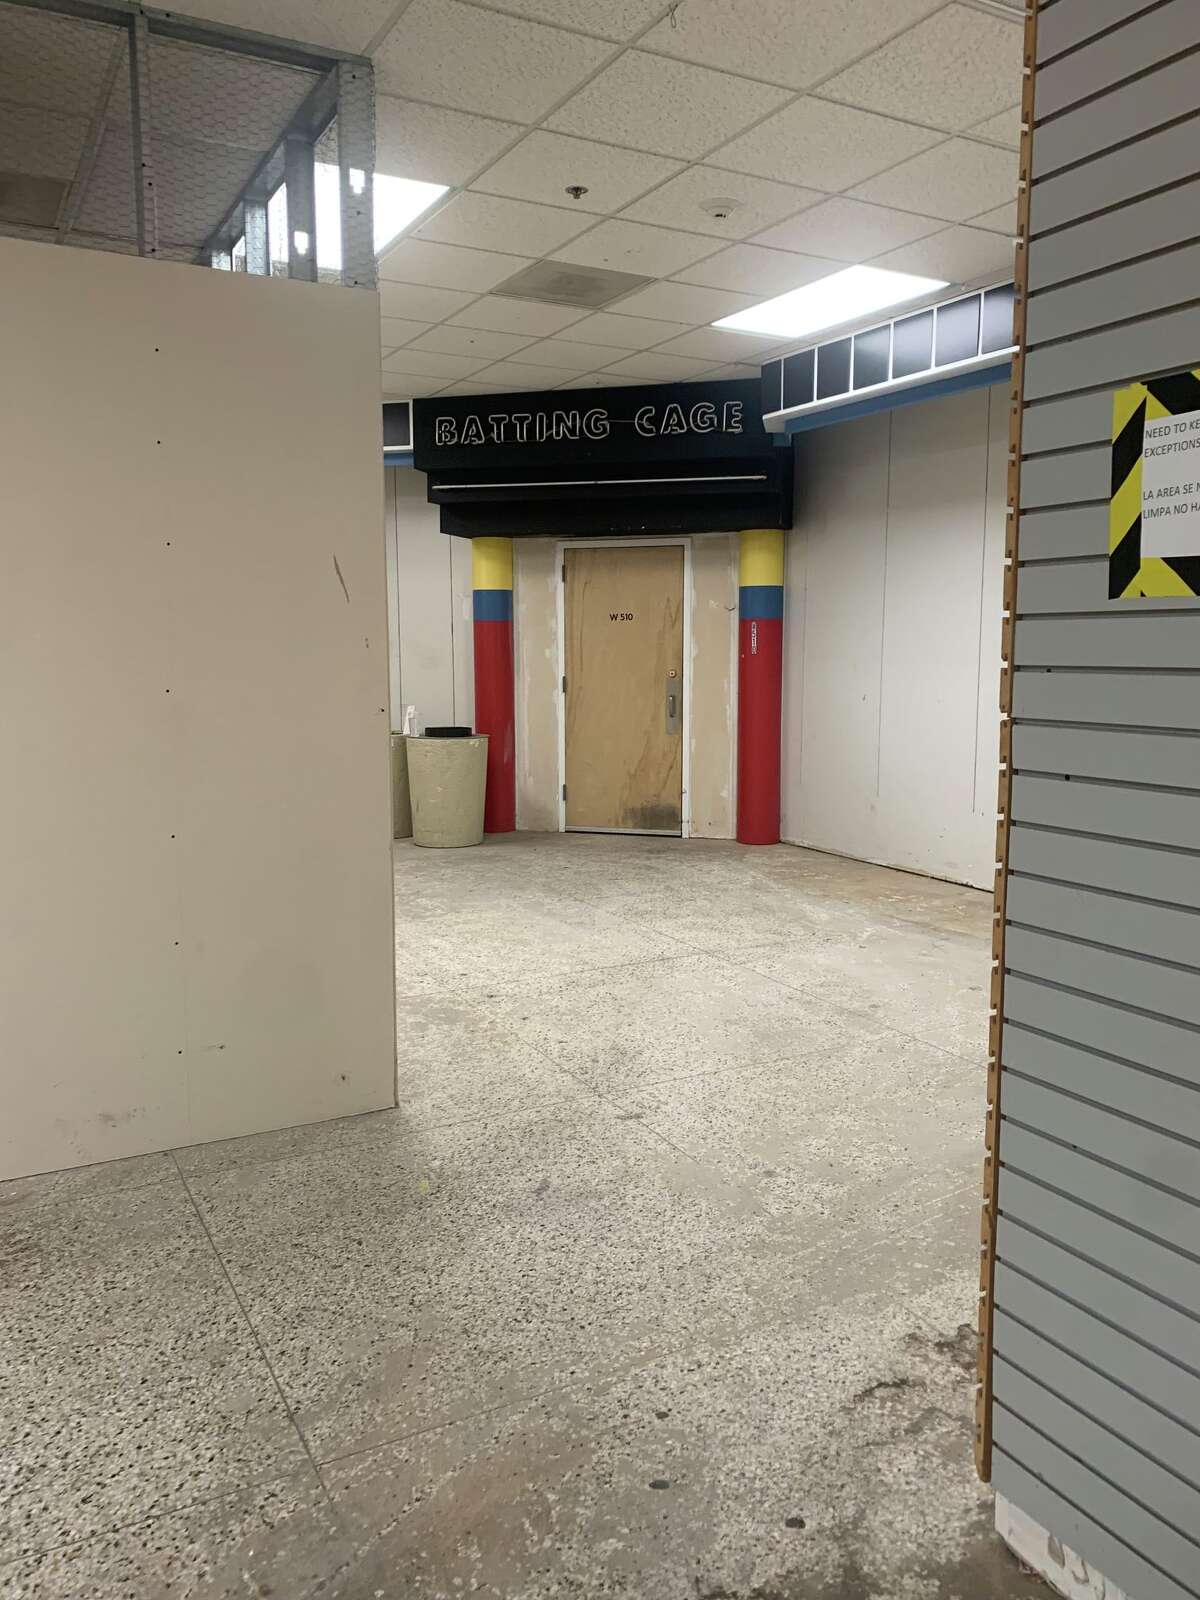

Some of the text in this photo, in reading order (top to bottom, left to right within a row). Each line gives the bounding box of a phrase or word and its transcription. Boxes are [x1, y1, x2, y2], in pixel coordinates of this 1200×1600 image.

[435, 401, 744, 446] BATTING CAGE
[1145, 425, 1171, 439] NEED
[1174, 422, 1187, 434] TO
[1144, 438, 1200, 458] EXCEPTIONS
[1143, 490, 1154, 501] LA
[1156, 485, 1180, 498] AREA
[1183, 483, 1193, 495] SE
[1143, 506, 1171, 520] LIMPA
[1174, 503, 1188, 514] NO
[609, 612, 634, 621] W 510
